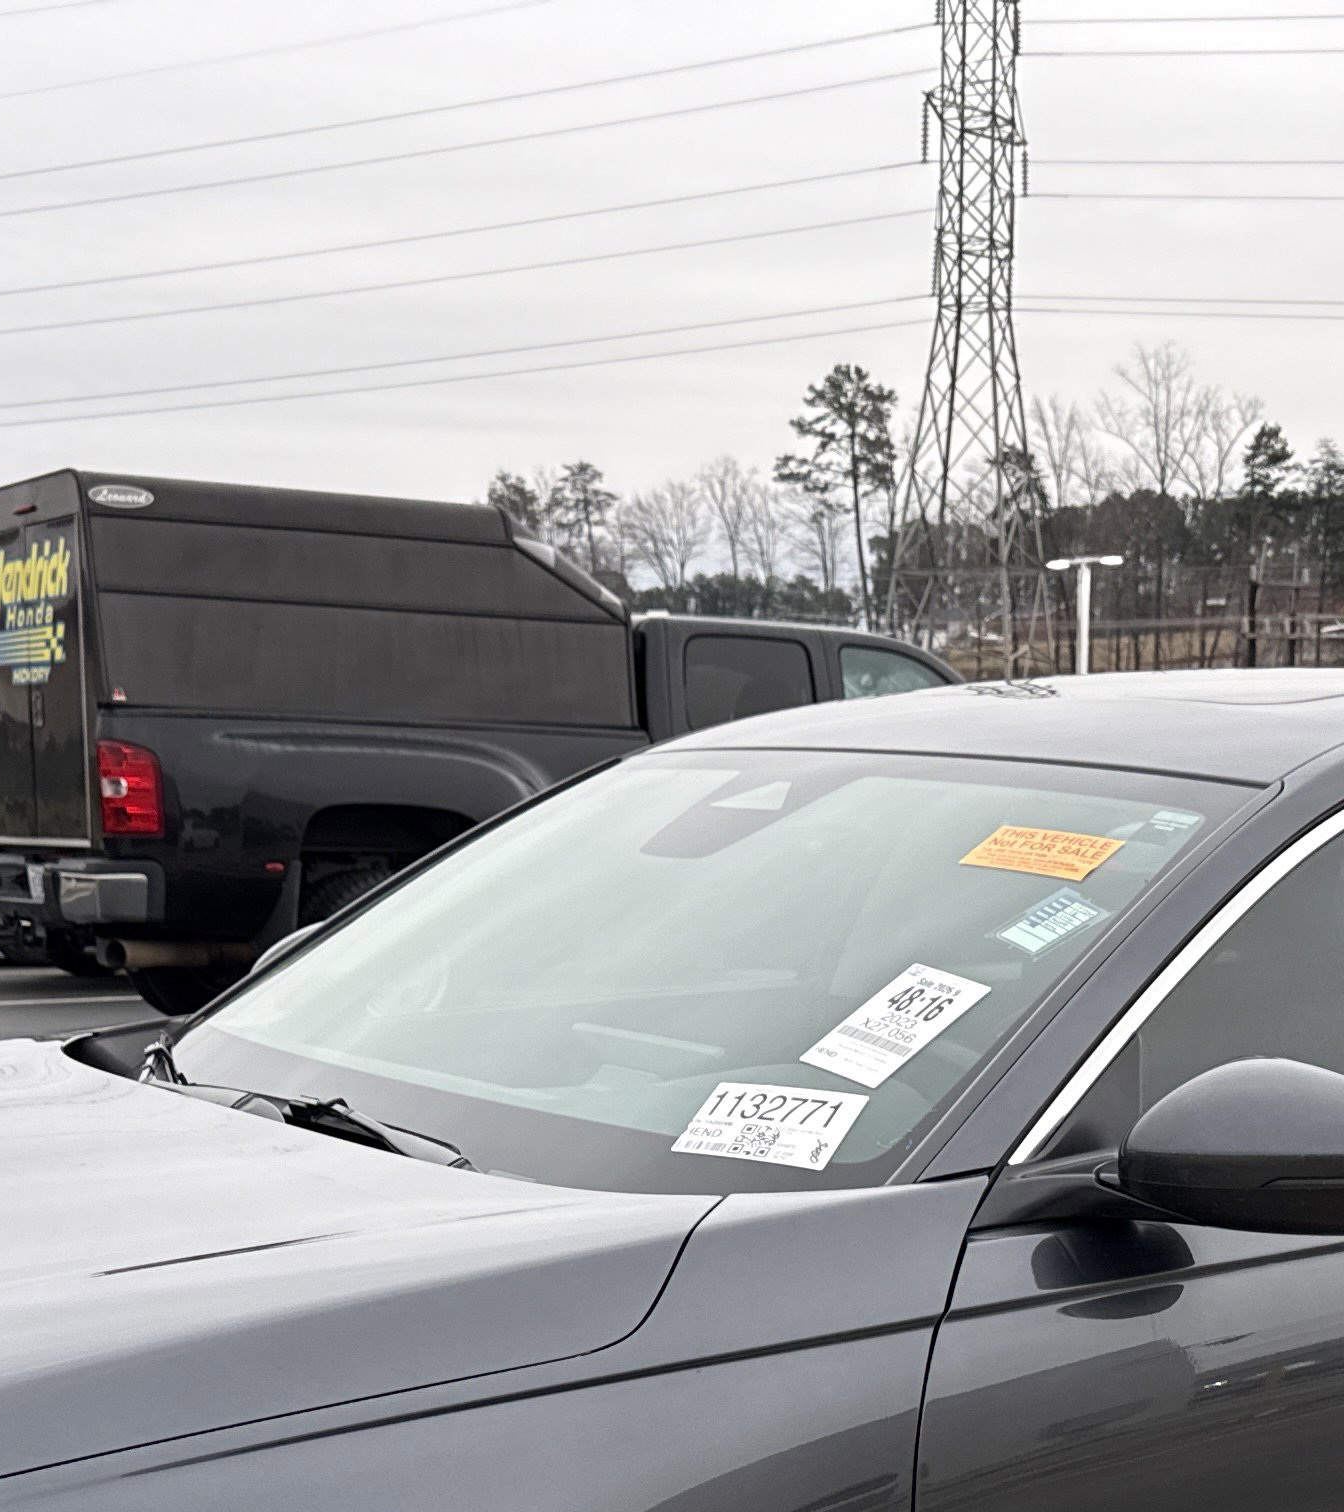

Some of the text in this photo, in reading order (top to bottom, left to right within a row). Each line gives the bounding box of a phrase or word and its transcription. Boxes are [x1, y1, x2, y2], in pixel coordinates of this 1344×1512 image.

[6, 602, 54, 630] Honda
[1001, 828, 1114, 851] THIS VEHICLE
[1020, 841, 1057, 853] FOR
[1058, 845, 1105, 861] SALE
[887, 986, 954, 1022] 48:16
[859, 1017, 918, 1044] X27 056
[880, 1012, 918, 1030] 2023
[708, 1090, 844, 1128] 1132771
